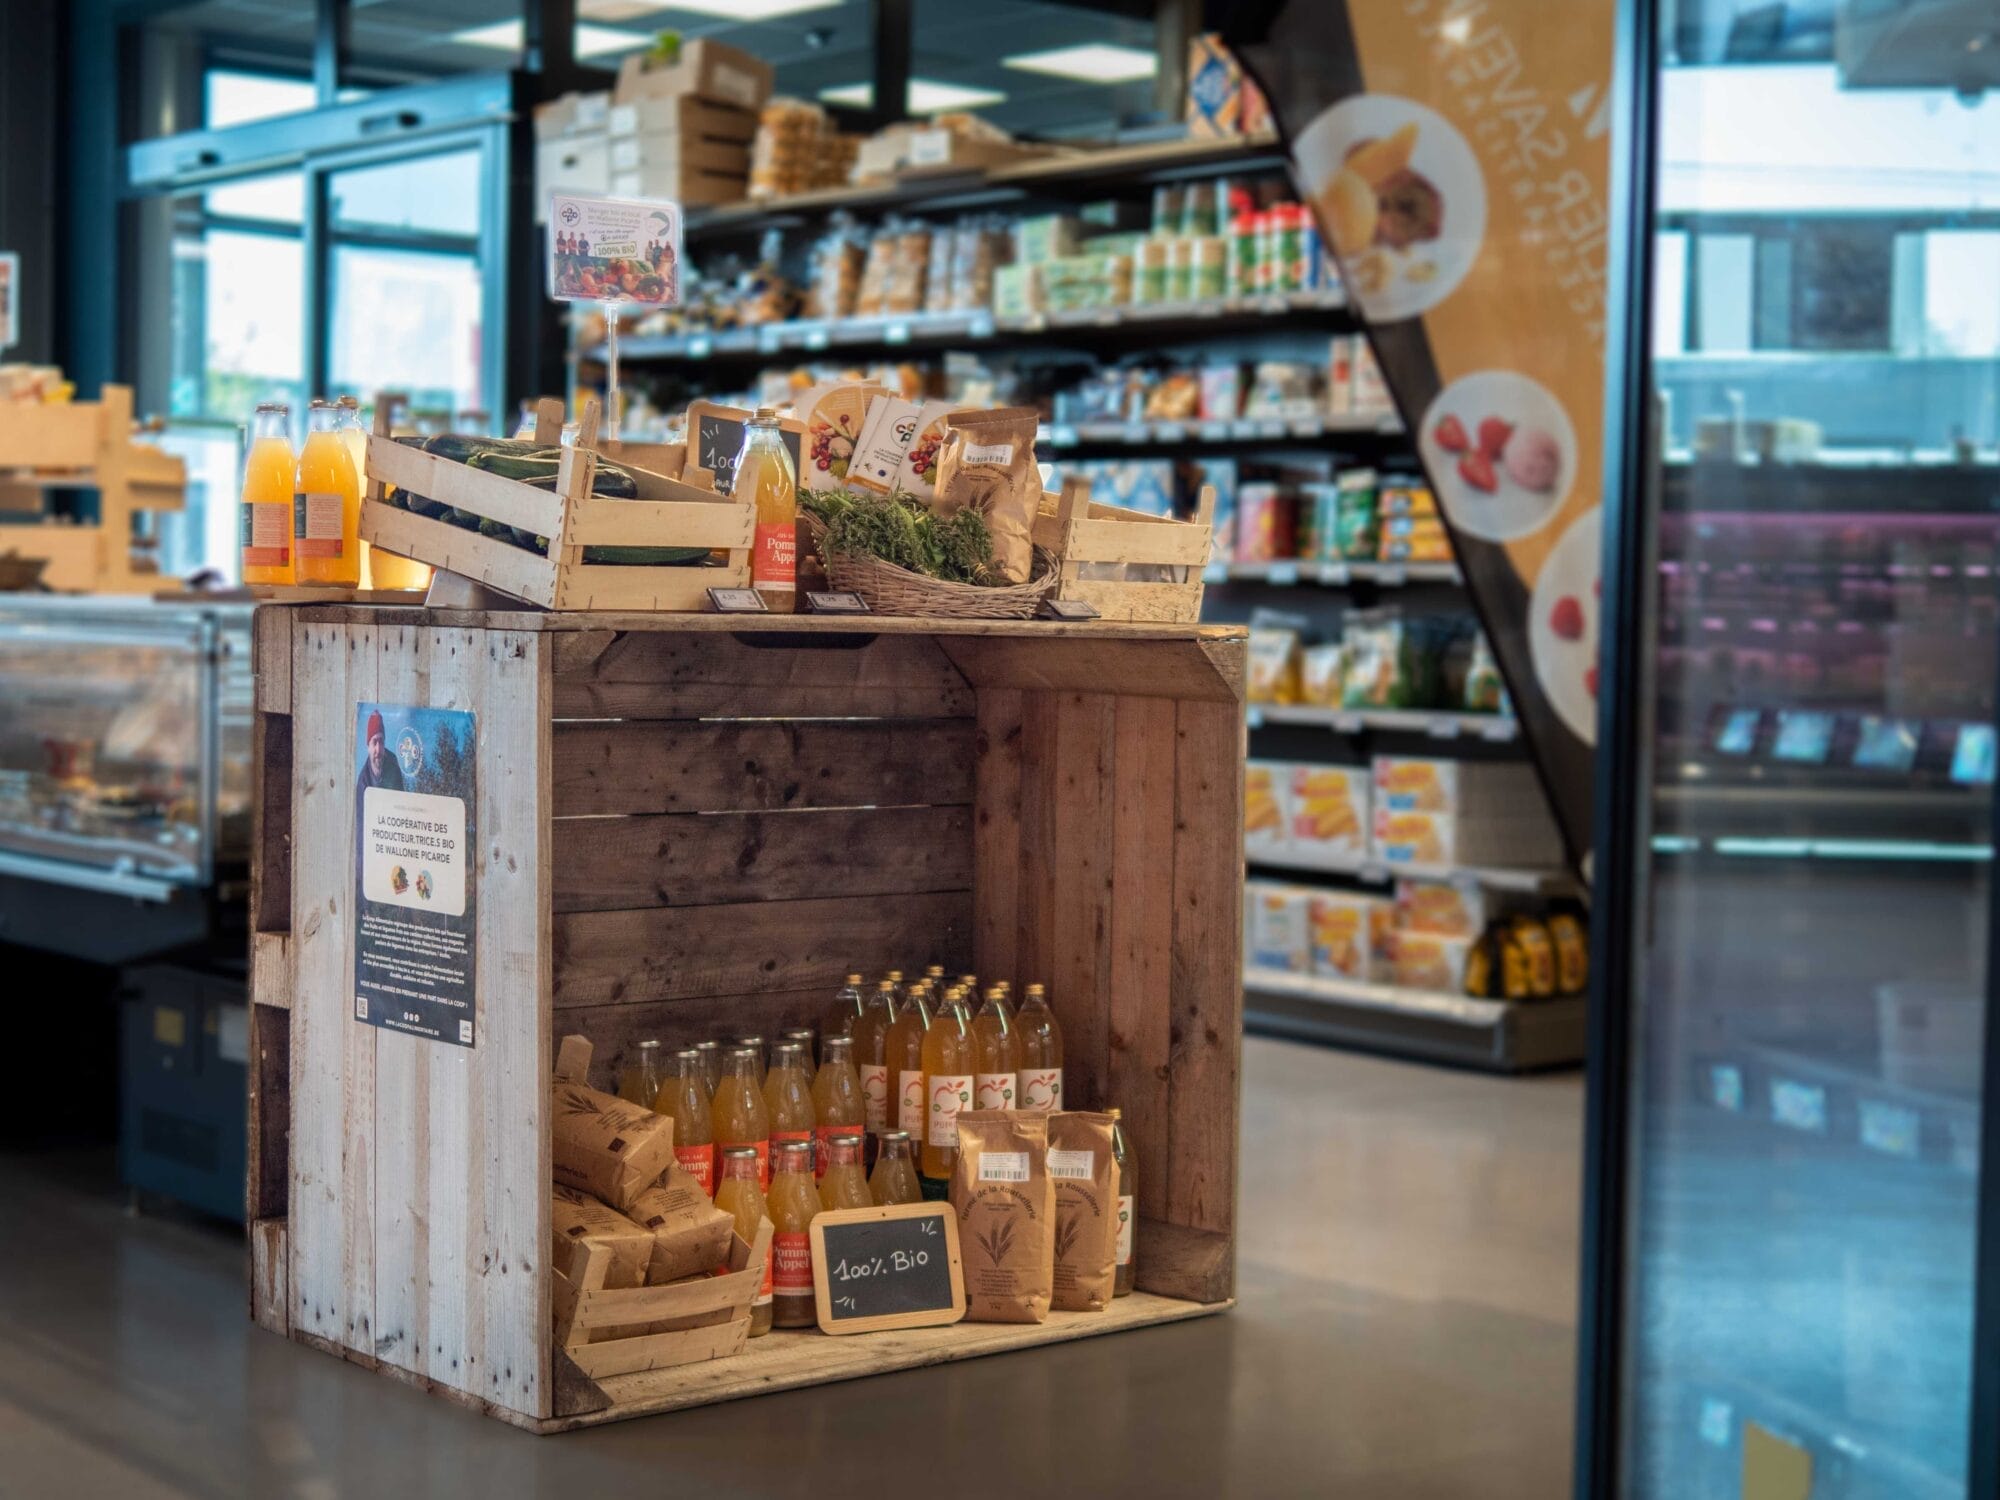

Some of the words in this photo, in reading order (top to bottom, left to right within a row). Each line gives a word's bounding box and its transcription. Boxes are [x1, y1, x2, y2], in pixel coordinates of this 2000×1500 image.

[598, 247, 620, 256] 100%
[622, 244, 635, 254] BIO
[378, 815, 386, 825] LA
[386, 815, 432, 832] COOPÉRATIVE
[434, 823, 448, 834] DES
[372, 828, 441, 848] PRODUCTEUR.TRICE.S
[442, 838, 455, 850] BIO
[375, 844, 384, 854] DE
[386, 845, 420, 860] WALLONIE
[421, 850, 450, 864] PICARDE
[833, 1258, 888, 1281] 100%
[890, 1249, 929, 1272] Bio
